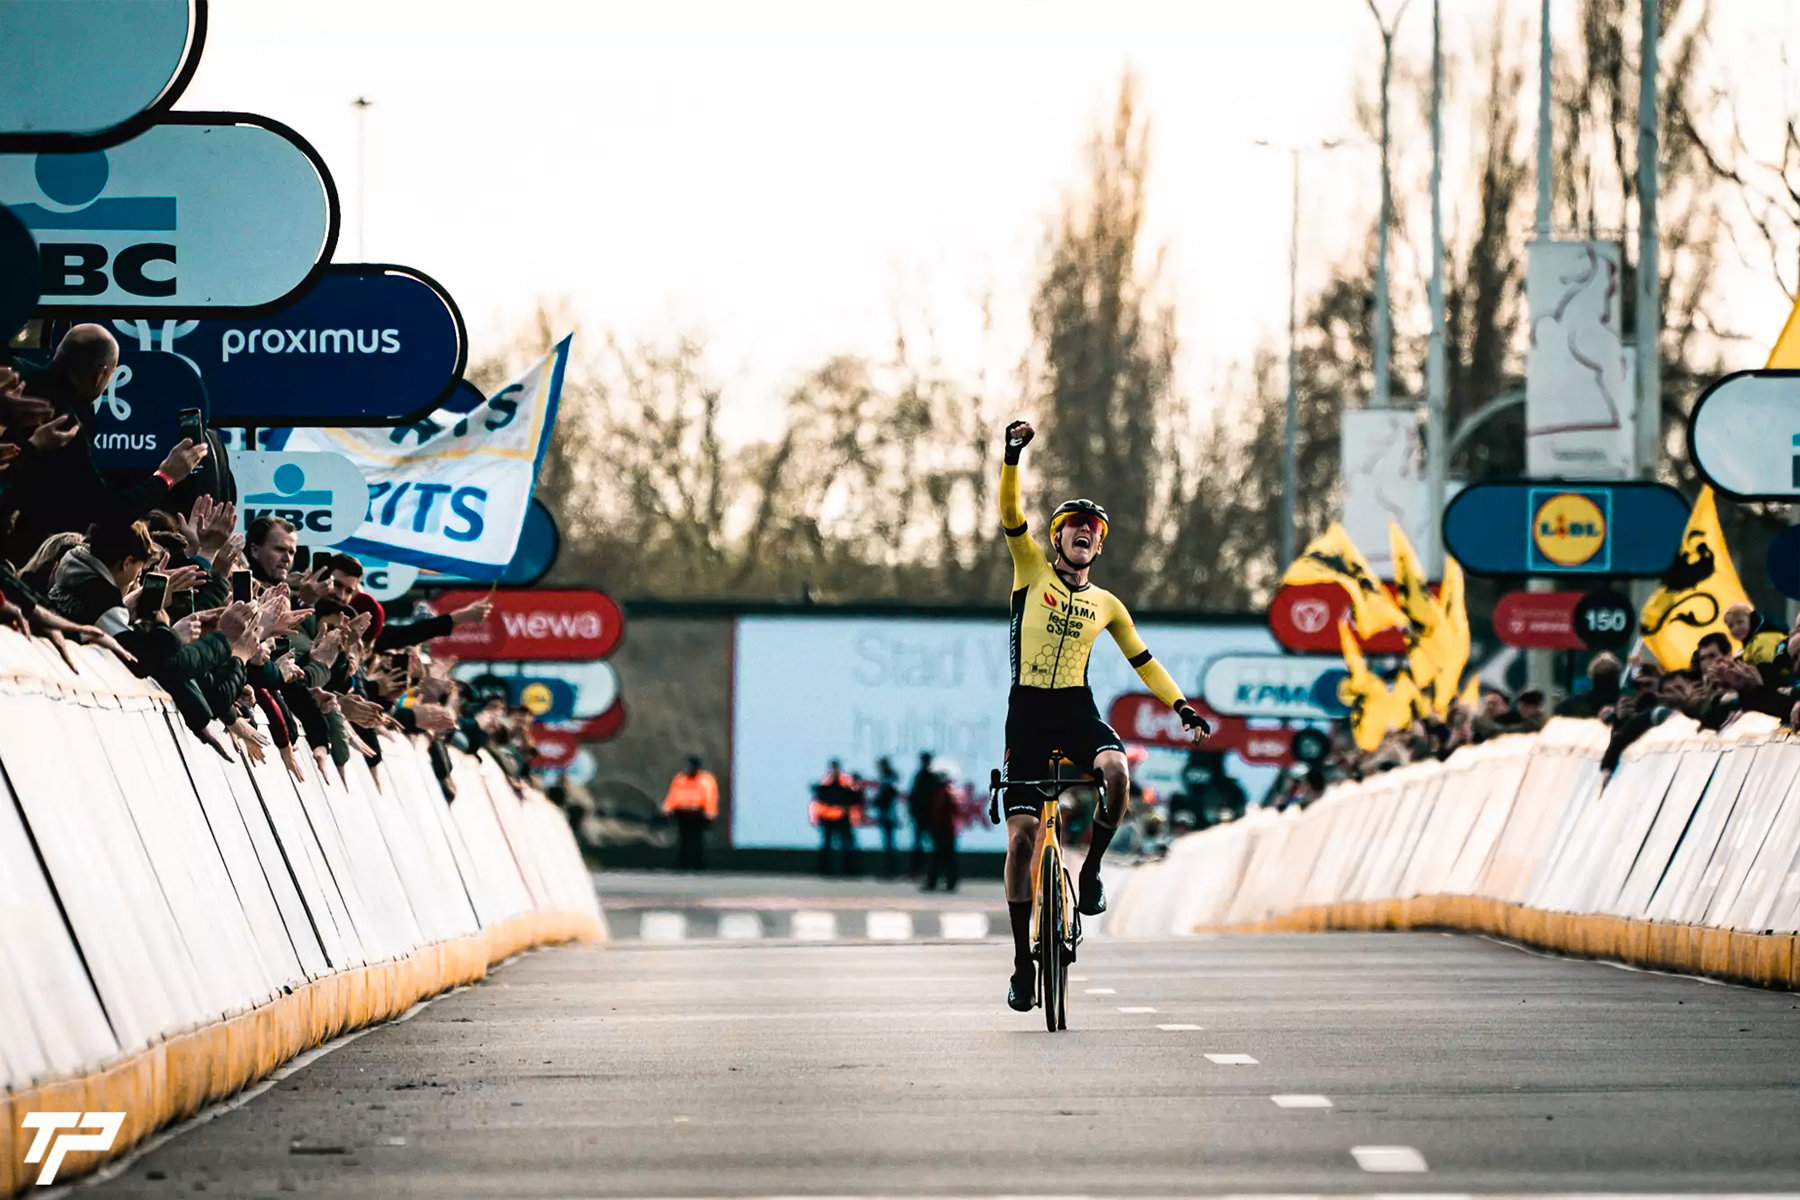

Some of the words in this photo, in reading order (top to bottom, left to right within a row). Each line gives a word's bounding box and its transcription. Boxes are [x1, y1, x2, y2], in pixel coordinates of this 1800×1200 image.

[39, 242, 177, 297] BC
[222, 328, 401, 362] proximus
[244, 508, 332, 533] KBC
[1048, 612, 1084, 631] lease
[1061, 601, 1096, 621] VISMA
[1585, 609, 1627, 631] 150
